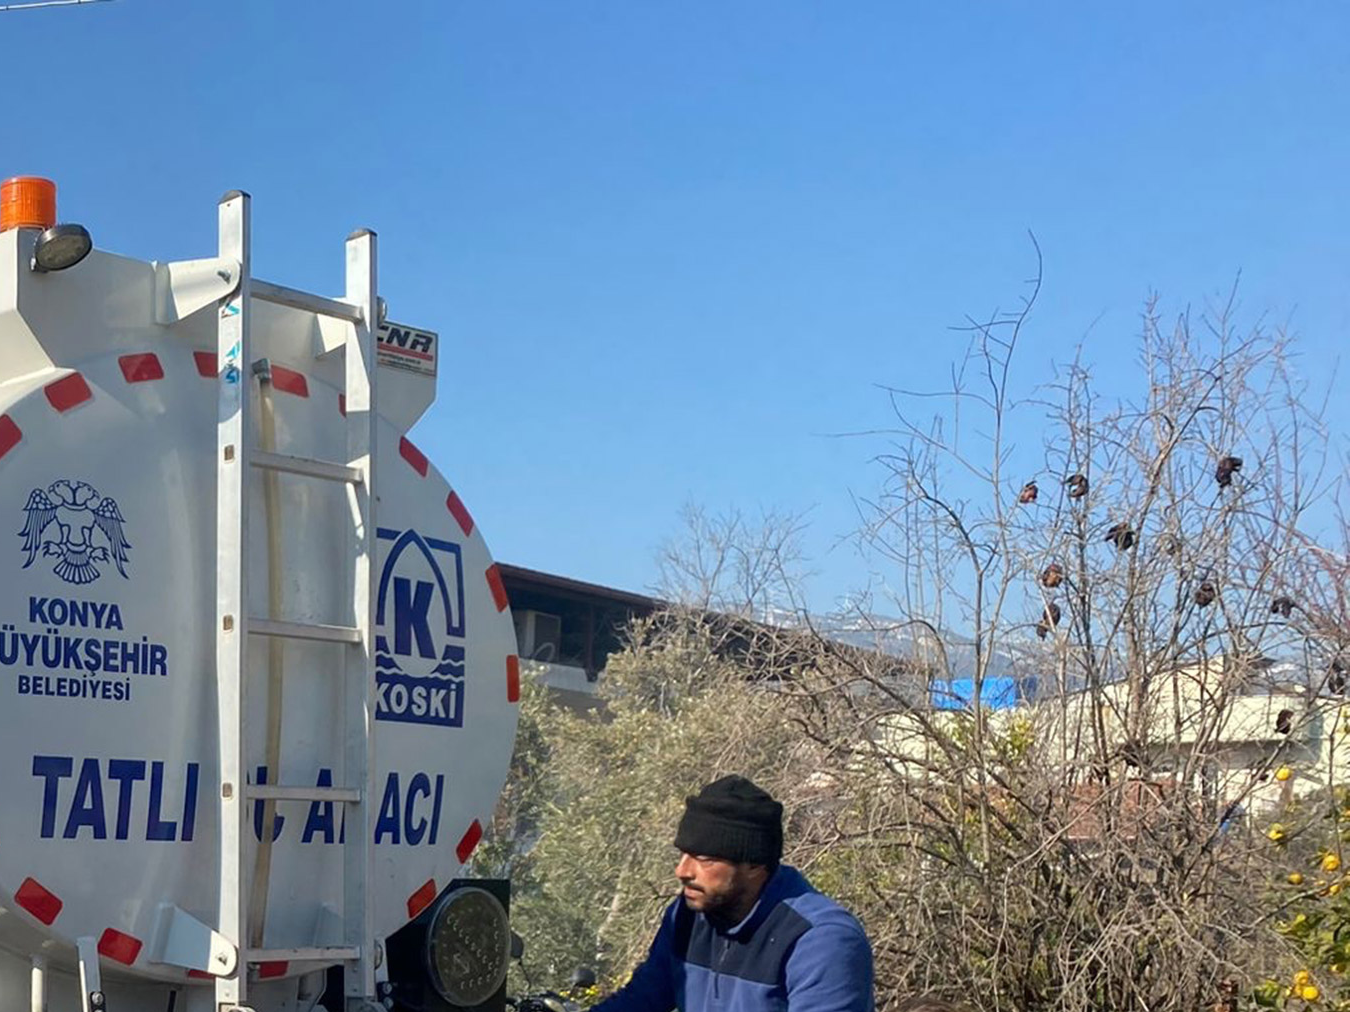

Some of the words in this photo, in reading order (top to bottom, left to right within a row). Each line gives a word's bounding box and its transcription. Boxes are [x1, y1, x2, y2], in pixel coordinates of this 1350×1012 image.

[29, 596, 124, 631] KONYA
[18, 673, 130, 701] BELEDİYESİ
[32, 754, 199, 842] TATLI
[300, 767, 445, 846] AACI
